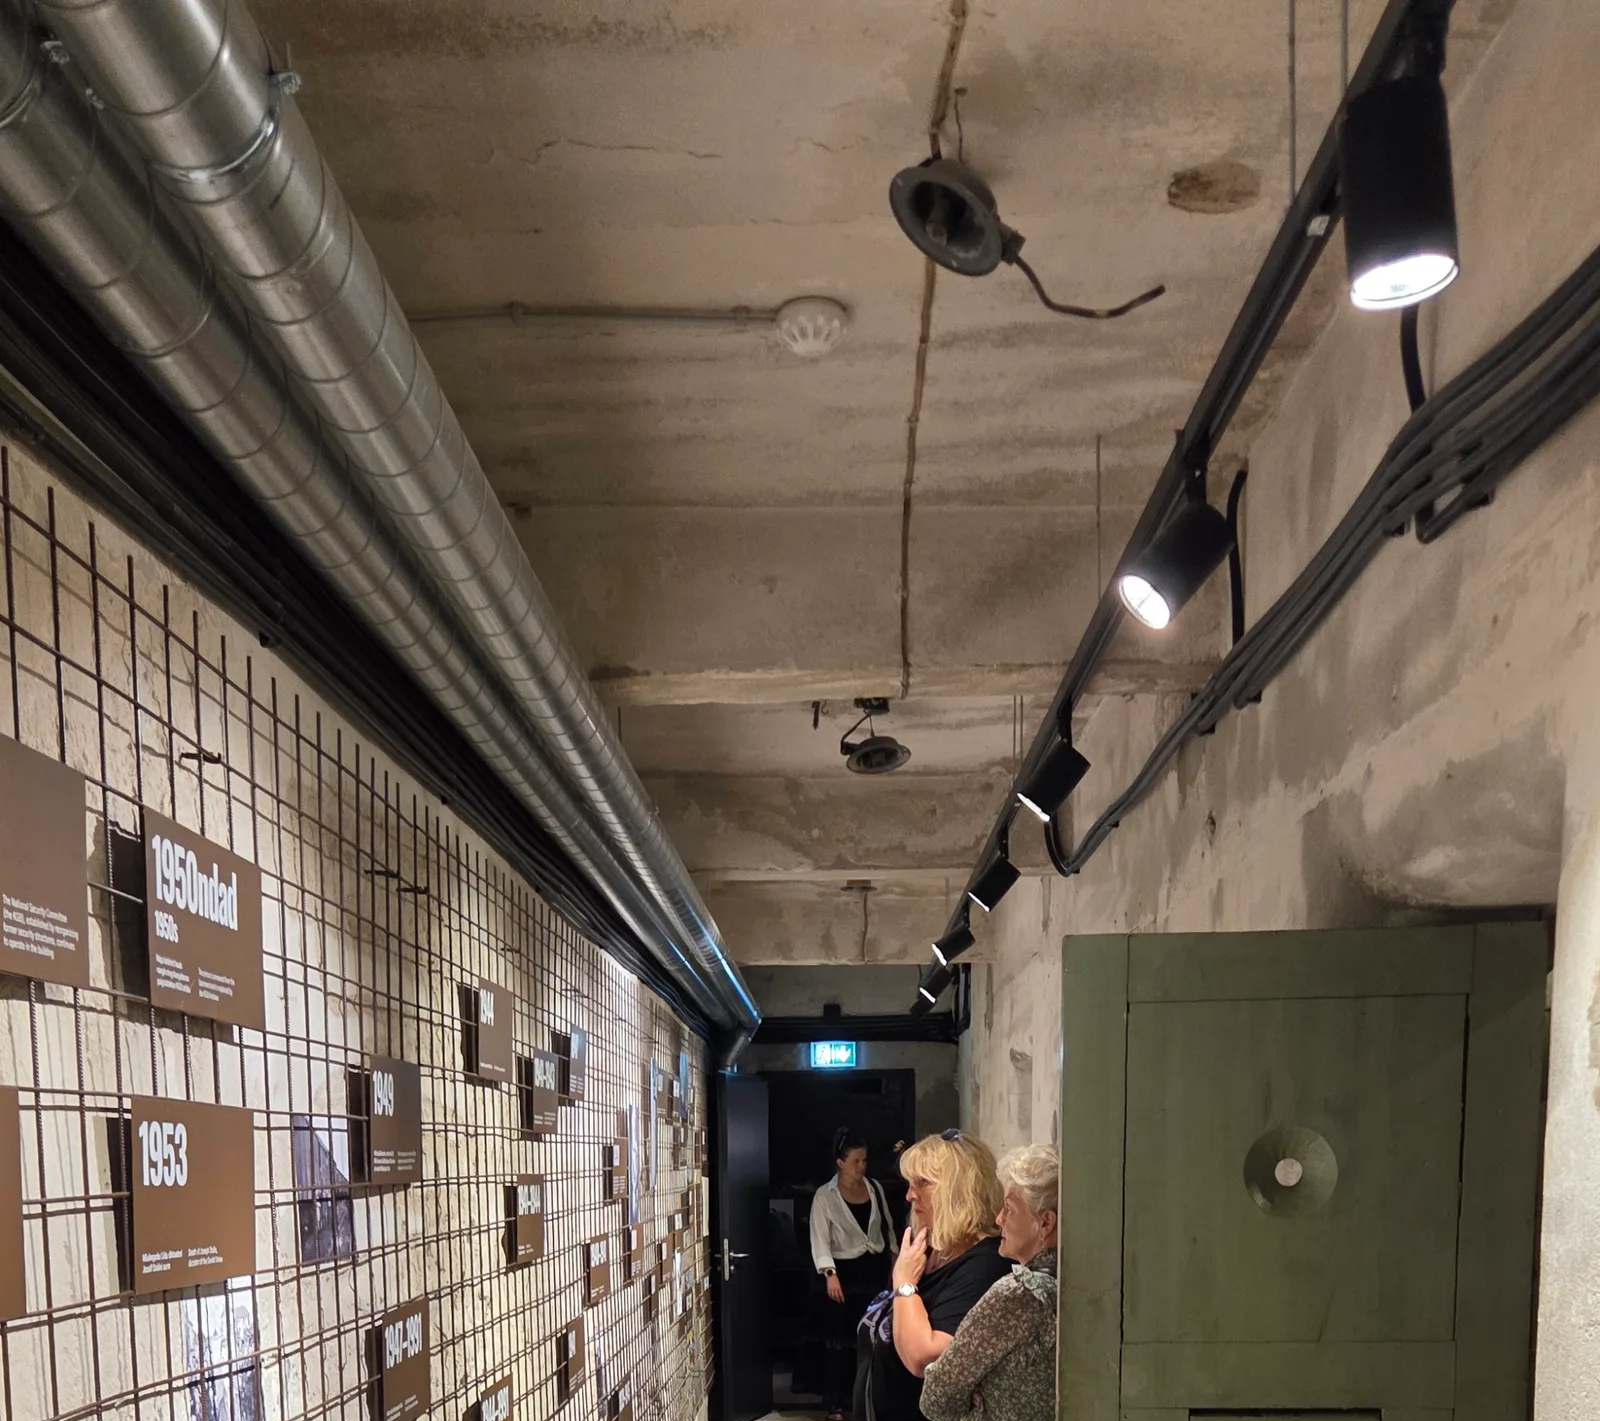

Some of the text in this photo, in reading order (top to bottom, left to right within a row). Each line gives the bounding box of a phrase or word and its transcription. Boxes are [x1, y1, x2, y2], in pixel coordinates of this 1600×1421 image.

[152, 834, 238, 931] 1950ndad
[154, 910, 179, 943] 1950s
[372, 1070, 394, 1117] 1949
[138, 1120, 188, 1187] 1953
